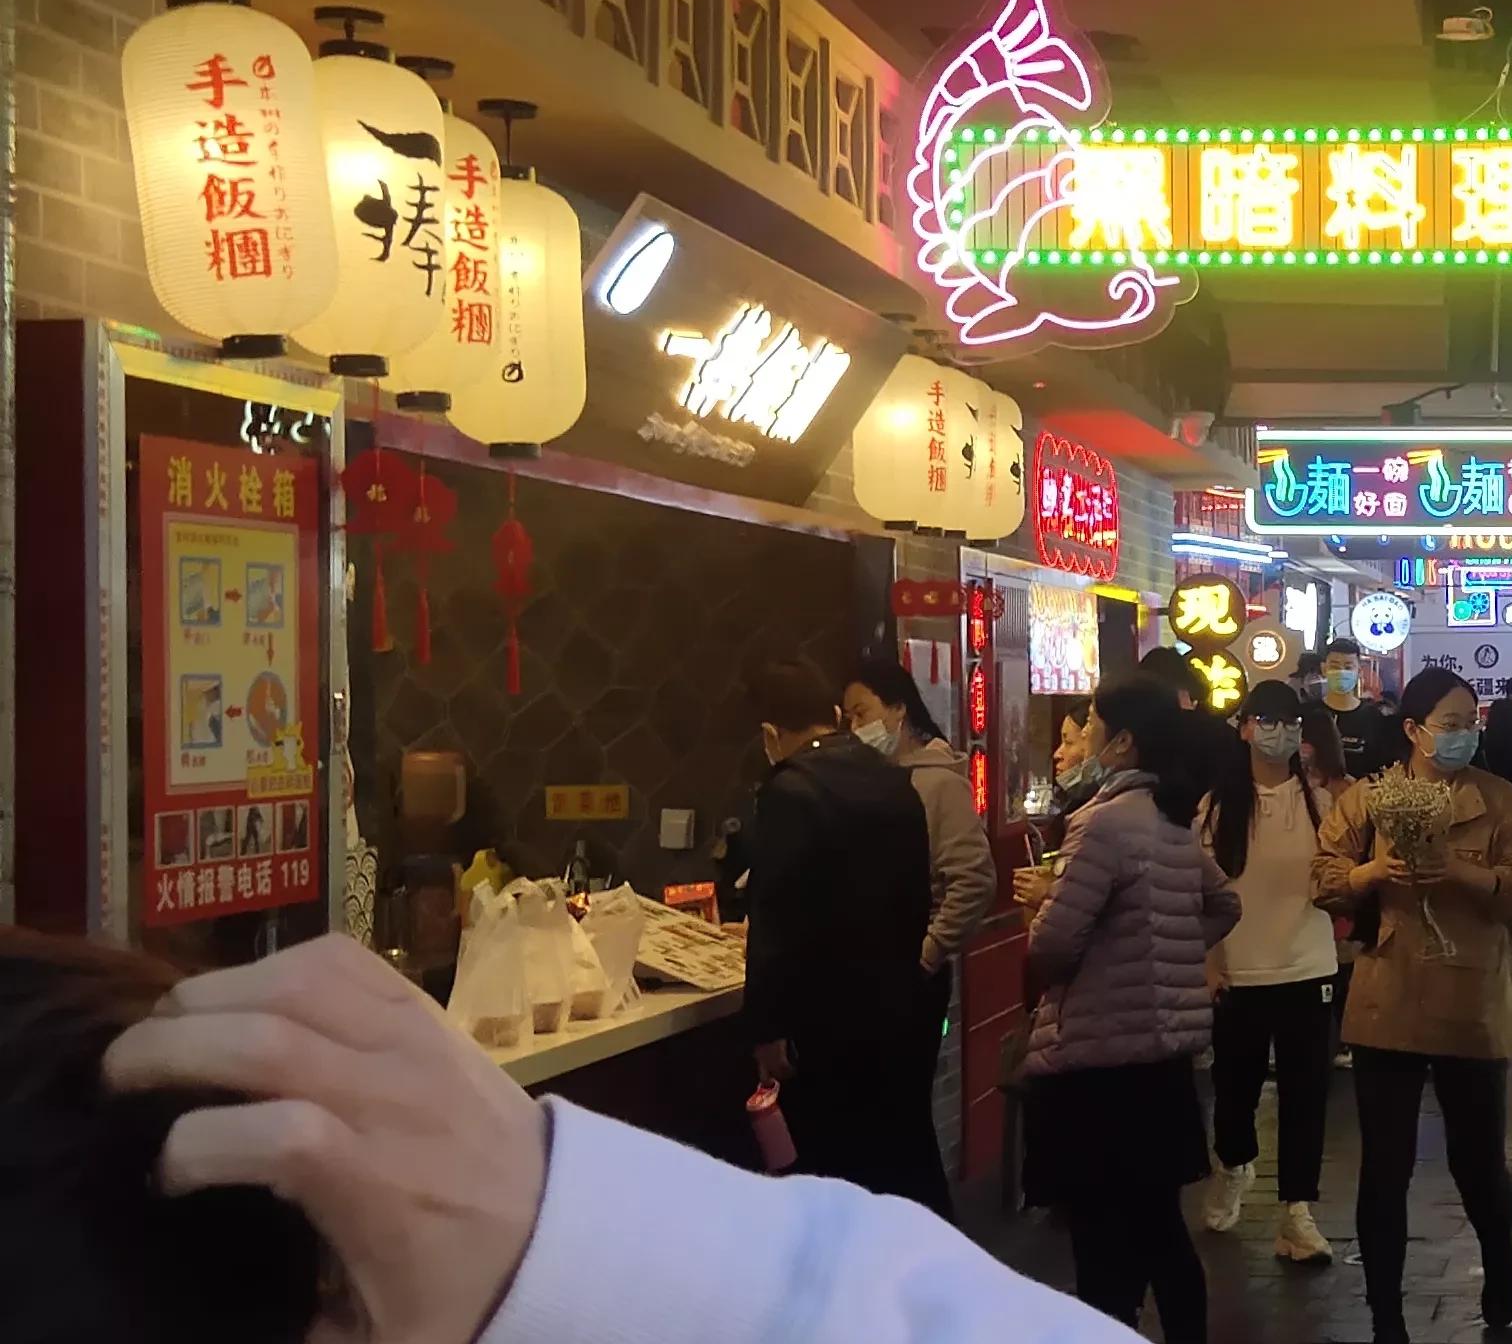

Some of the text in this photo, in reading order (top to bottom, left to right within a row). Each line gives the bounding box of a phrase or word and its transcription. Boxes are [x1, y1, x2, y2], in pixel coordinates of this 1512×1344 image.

[167, 456, 297, 519] 消火栓箱
[1353, 456, 1410, 484] 一碗
[1353, 491, 1408, 518] 好面
[156, 858, 311, 912] 火情报警电话 119
